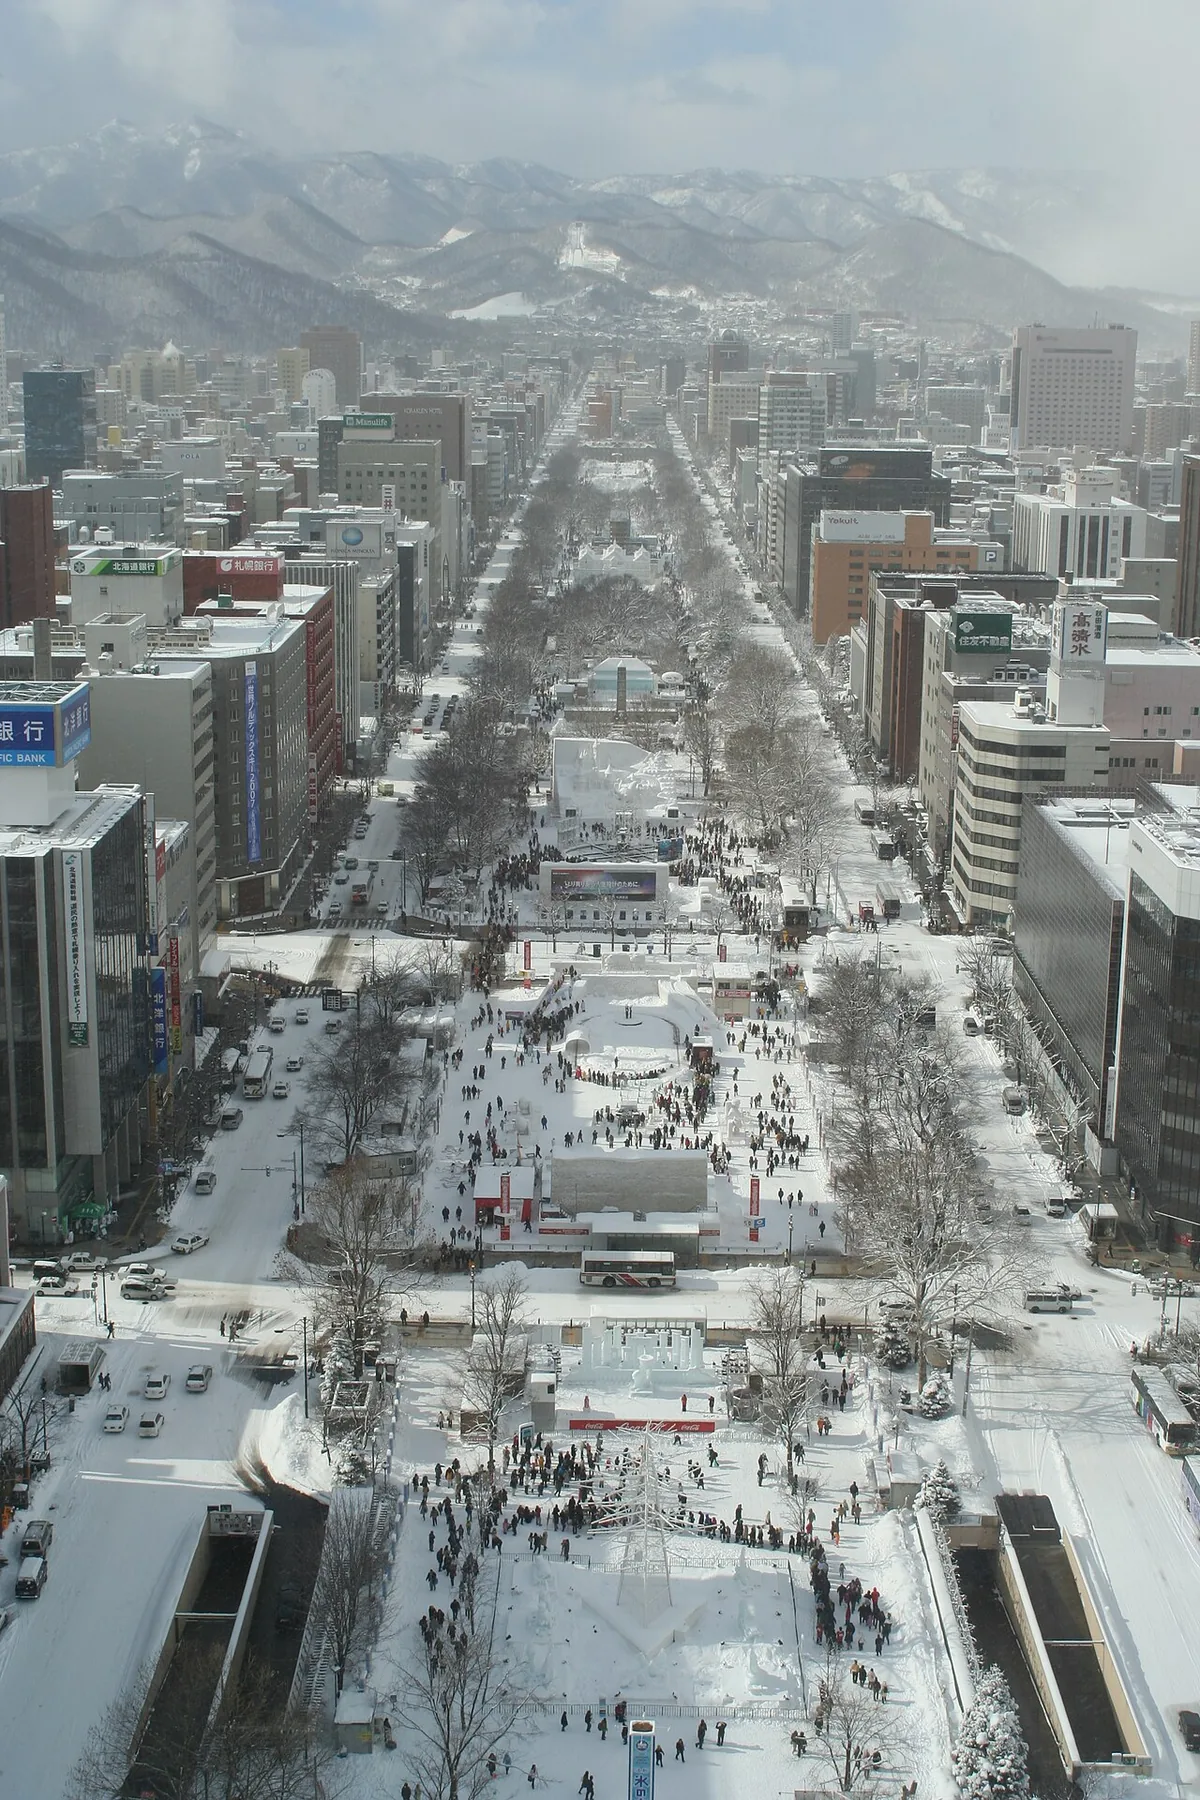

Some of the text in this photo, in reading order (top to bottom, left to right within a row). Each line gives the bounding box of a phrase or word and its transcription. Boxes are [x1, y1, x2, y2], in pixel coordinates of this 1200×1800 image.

[355, 417, 388, 426] Manulife
[828, 517, 859, 525] Yakult
[985, 551, 996, 562] P
[112, 562, 155, 571] 北海道銀行
[234, 560, 273, 571] 札幌銀行
[958, 635, 1010, 647] 住友不動産
[0, 720, 44, 741] 銀行
[17, 753, 46, 763] BANK
[154, 993, 165, 1048] 北洋銀行
